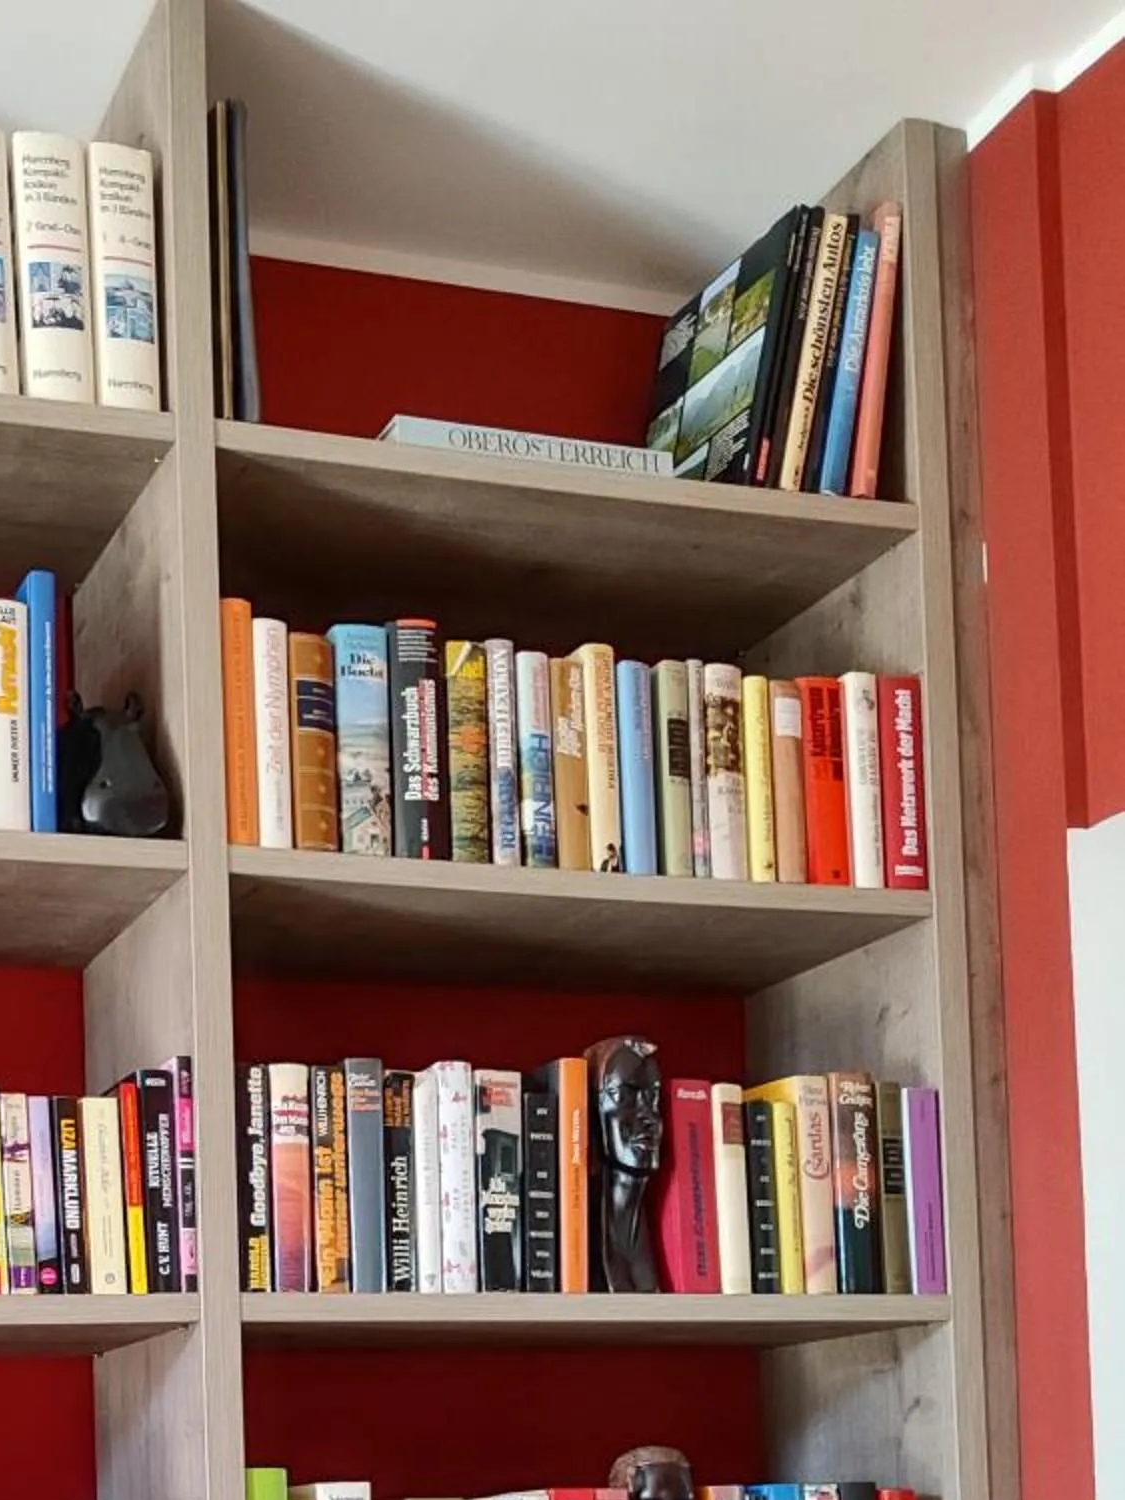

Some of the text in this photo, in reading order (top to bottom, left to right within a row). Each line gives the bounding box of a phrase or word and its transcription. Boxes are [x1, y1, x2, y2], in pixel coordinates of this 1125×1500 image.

[802, 372, 817, 403] Die
[822, 222, 844, 275] Autos
[401, 687, 422, 801] Das Schwarzbuch
[901, 829, 919, 856] Das
[248, 1067, 264, 1137] Janette
[60, 1119, 81, 1229] LIZA MARKLUND
[390, 1155, 412, 1281] Willi Heinrich
[853, 1191, 870, 1229] Die
[157, 1221, 169, 1253] HUNT
